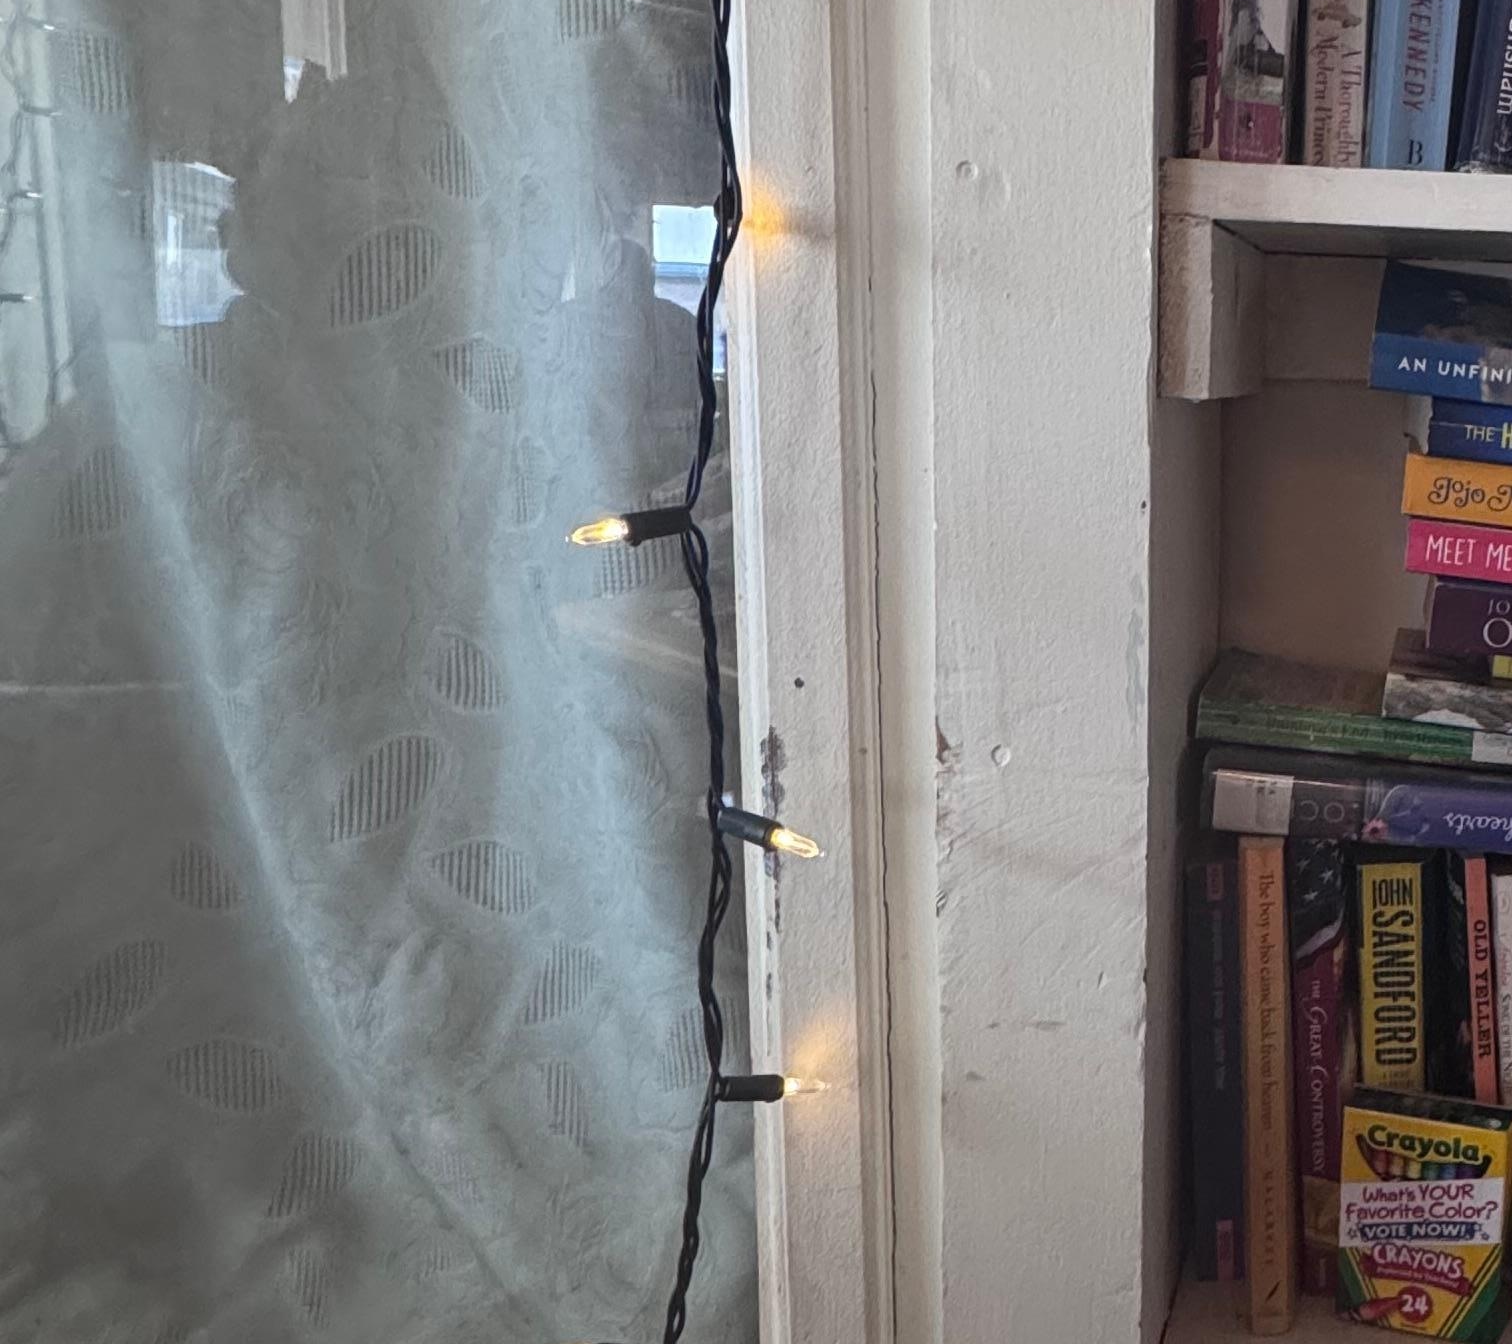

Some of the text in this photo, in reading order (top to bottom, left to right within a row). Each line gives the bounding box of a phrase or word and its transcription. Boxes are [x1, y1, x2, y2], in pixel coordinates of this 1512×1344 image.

[1397, 356, 1428, 372] AN
[1464, 424, 1496, 442] THE
[1427, 476, 1487, 508] Jojo
[1425, 534, 1476, 565] MEET
[1258, 871, 1277, 900] The
[1371, 877, 1414, 908] JOHN
[1255, 901, 1277, 931] boy
[1371, 909, 1418, 1067] SANDFORD
[1473, 918, 1492, 1058] OLD YELLER
[1306, 1006, 1328, 1058] GREAT
[1368, 1125, 1480, 1163] Crayola
[1363, 1183, 1475, 1203] What's YOUR
[1345, 1200, 1498, 1222] Favorite Color?
[1364, 1222, 1467, 1238] VOTE NOW!
[1372, 1241, 1465, 1280] CRAYONS
[1400, 1292, 1429, 1316] 24
